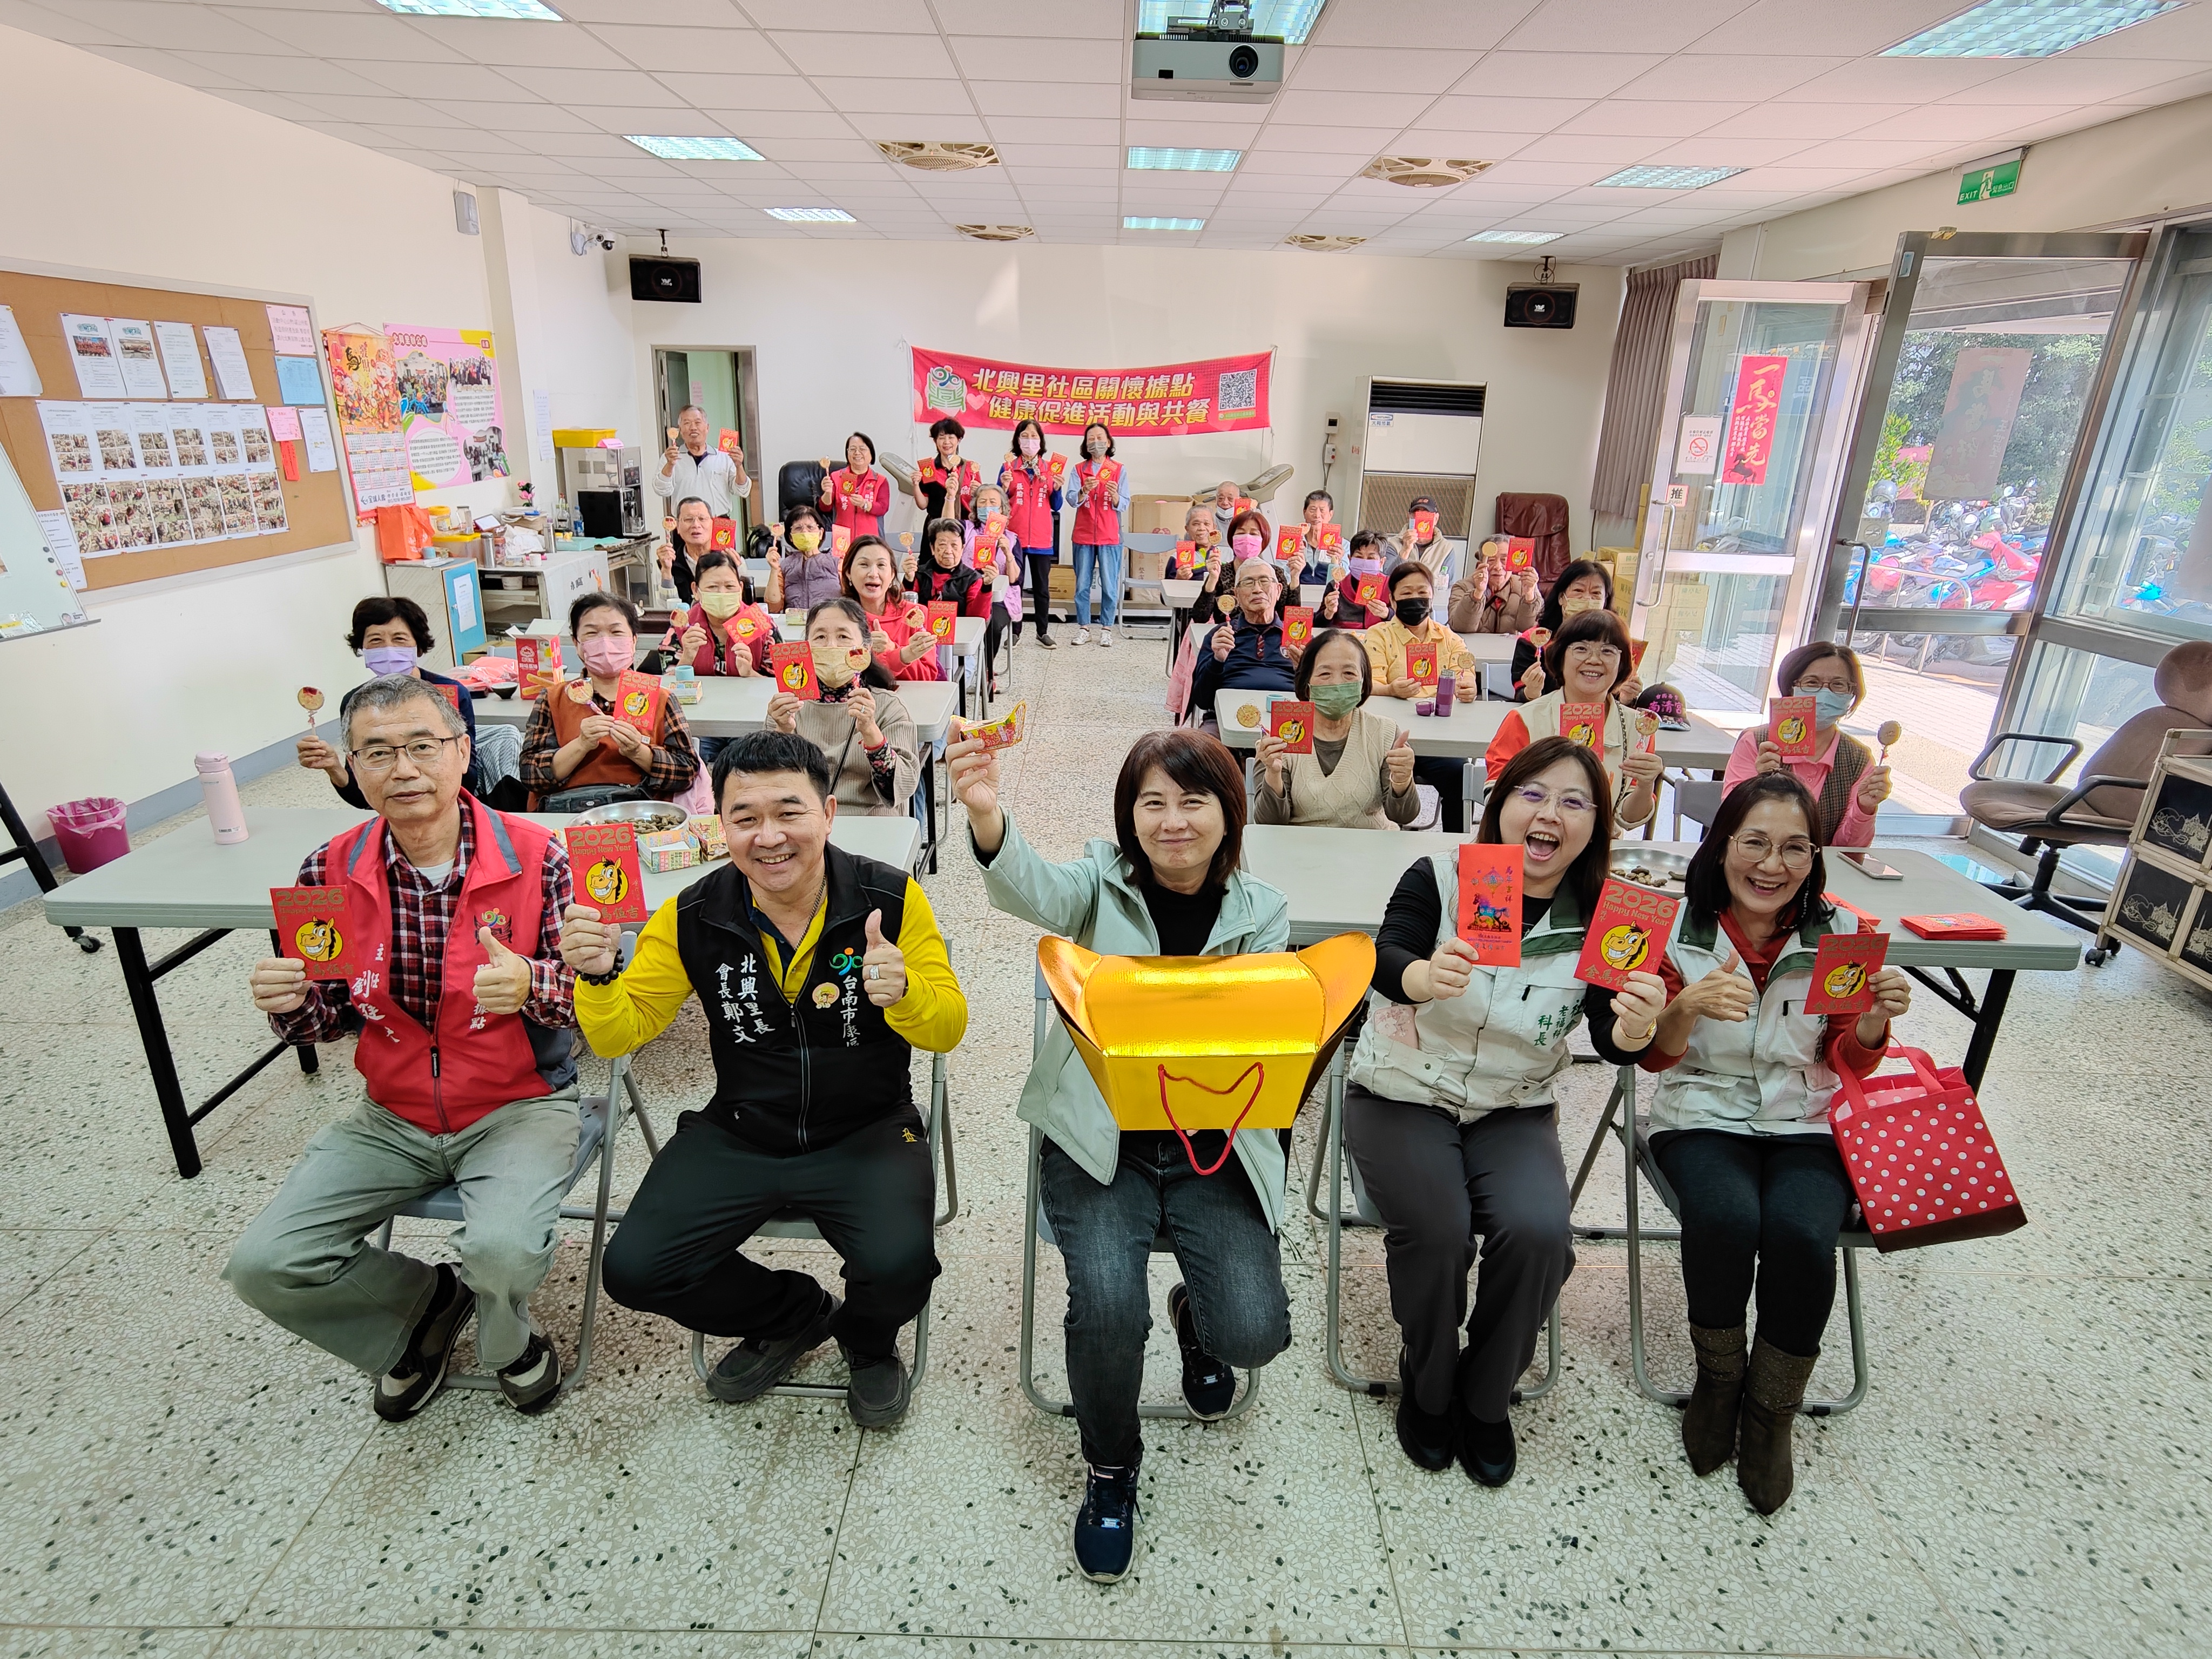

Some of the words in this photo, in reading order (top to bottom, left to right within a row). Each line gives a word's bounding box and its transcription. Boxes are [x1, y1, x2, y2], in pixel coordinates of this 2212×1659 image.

[1992, 181, 2015, 193] 緊急出口
[1959, 190, 1978, 201] EXIT
[972, 368, 1195, 400] 北興里社區關懷據點
[988, 395, 1210, 427] 健康促進活動與共餐
[1736, 363, 1781, 466] 一馬當先
[1670, 488, 1683, 500] 推
[930, 603, 955, 611] 2026
[773, 643, 809, 656] 2026
[1408, 645, 1435, 653] 2026
[622, 673, 658, 686] 2026
[1274, 702, 1312, 713] 2026
[1562, 704, 1602, 714] 2026
[1770, 697, 1813, 709] 2026
[569, 826, 631, 847] 2026
[572, 846, 596, 855] Happy
[275, 888, 345, 907] 2026
[1605, 885, 1675, 918] 2026
[1602, 900, 1630, 917] Happy
[1631, 909, 1649, 921] New
[1651, 914, 1669, 927] Year
[1824, 935, 1885, 952] 2026
[738, 953, 776, 1035] 北興里長
[1534, 1014, 1553, 1047] 科長
